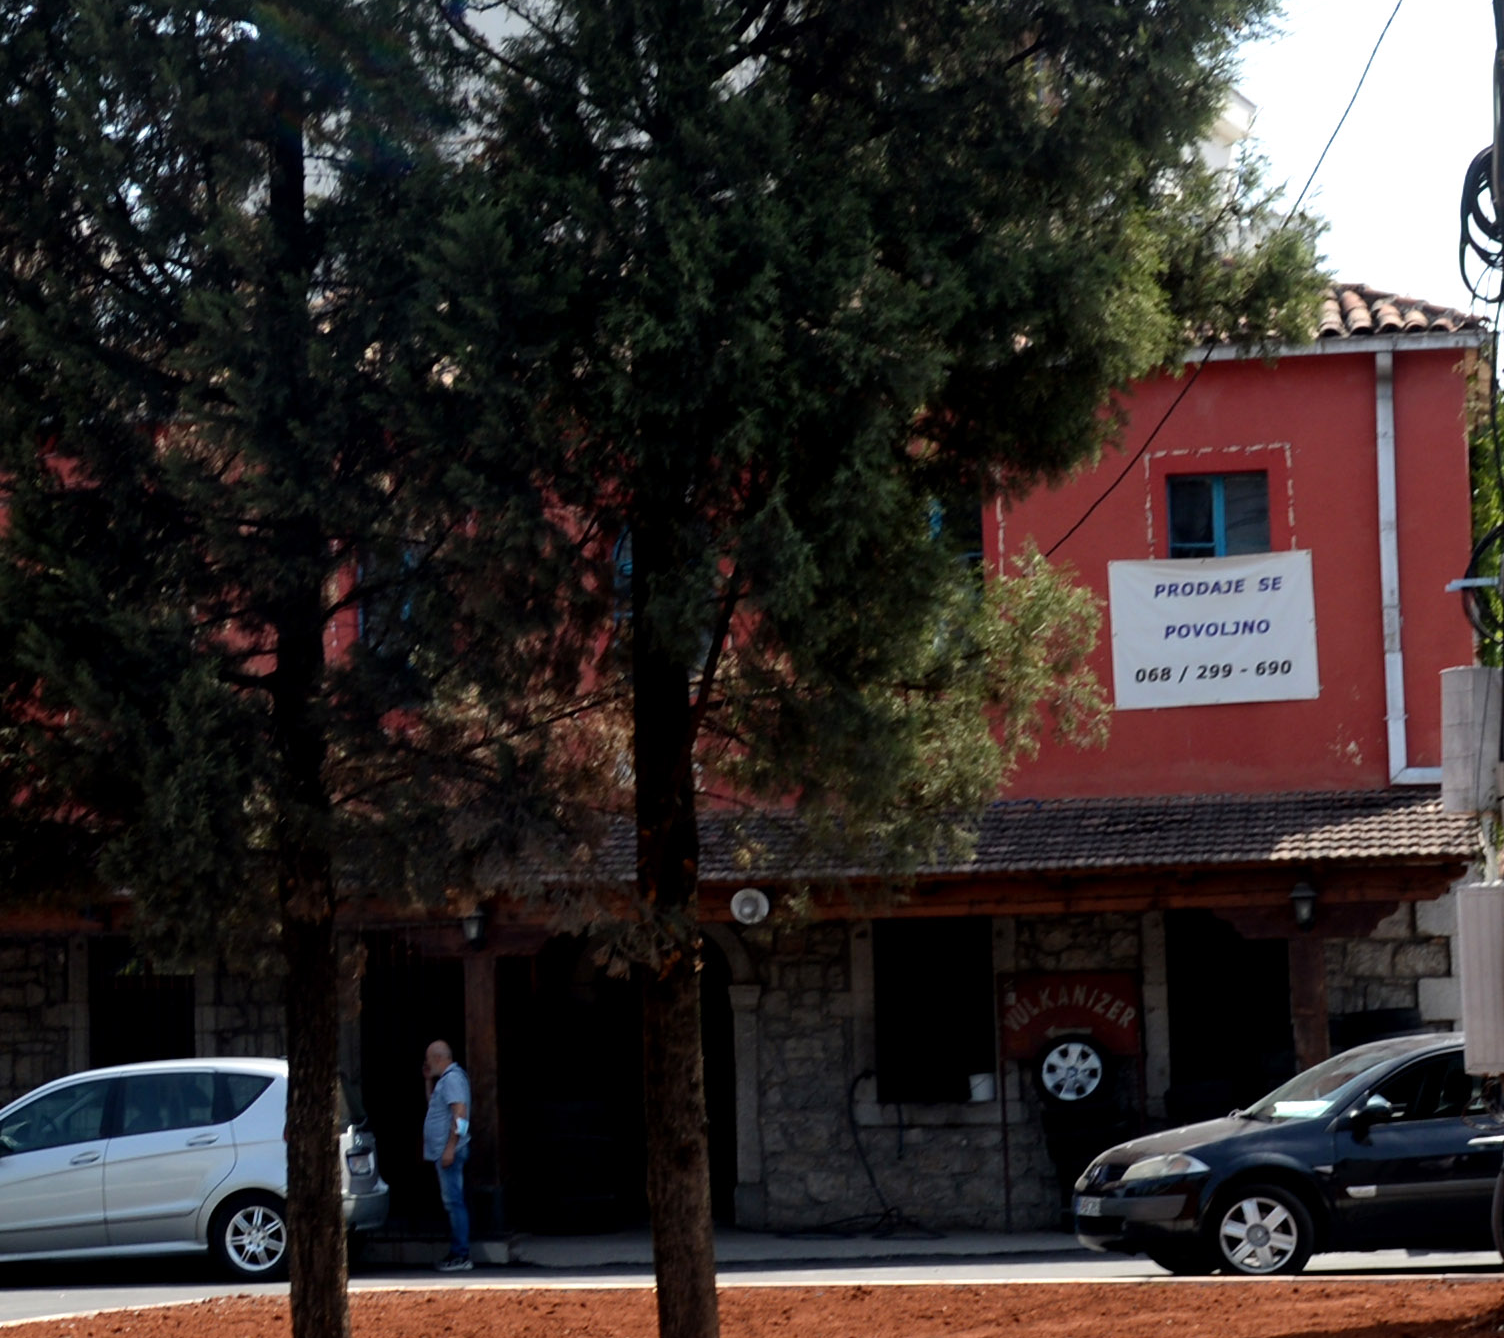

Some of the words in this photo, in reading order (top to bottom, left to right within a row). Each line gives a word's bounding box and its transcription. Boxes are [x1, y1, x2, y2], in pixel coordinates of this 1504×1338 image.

[1154, 578, 1246, 598] PRODAJE
[1257, 576, 1283, 592] SE
[1164, 619, 1271, 639] POVOLJNO
[1135, 666, 1172, 683] 068
[1178, 665, 1189, 683] /
[1196, 663, 1233, 680] 299
[1255, 659, 1292, 676] 690
[1004, 983, 1137, 1031] VULKANIZER
